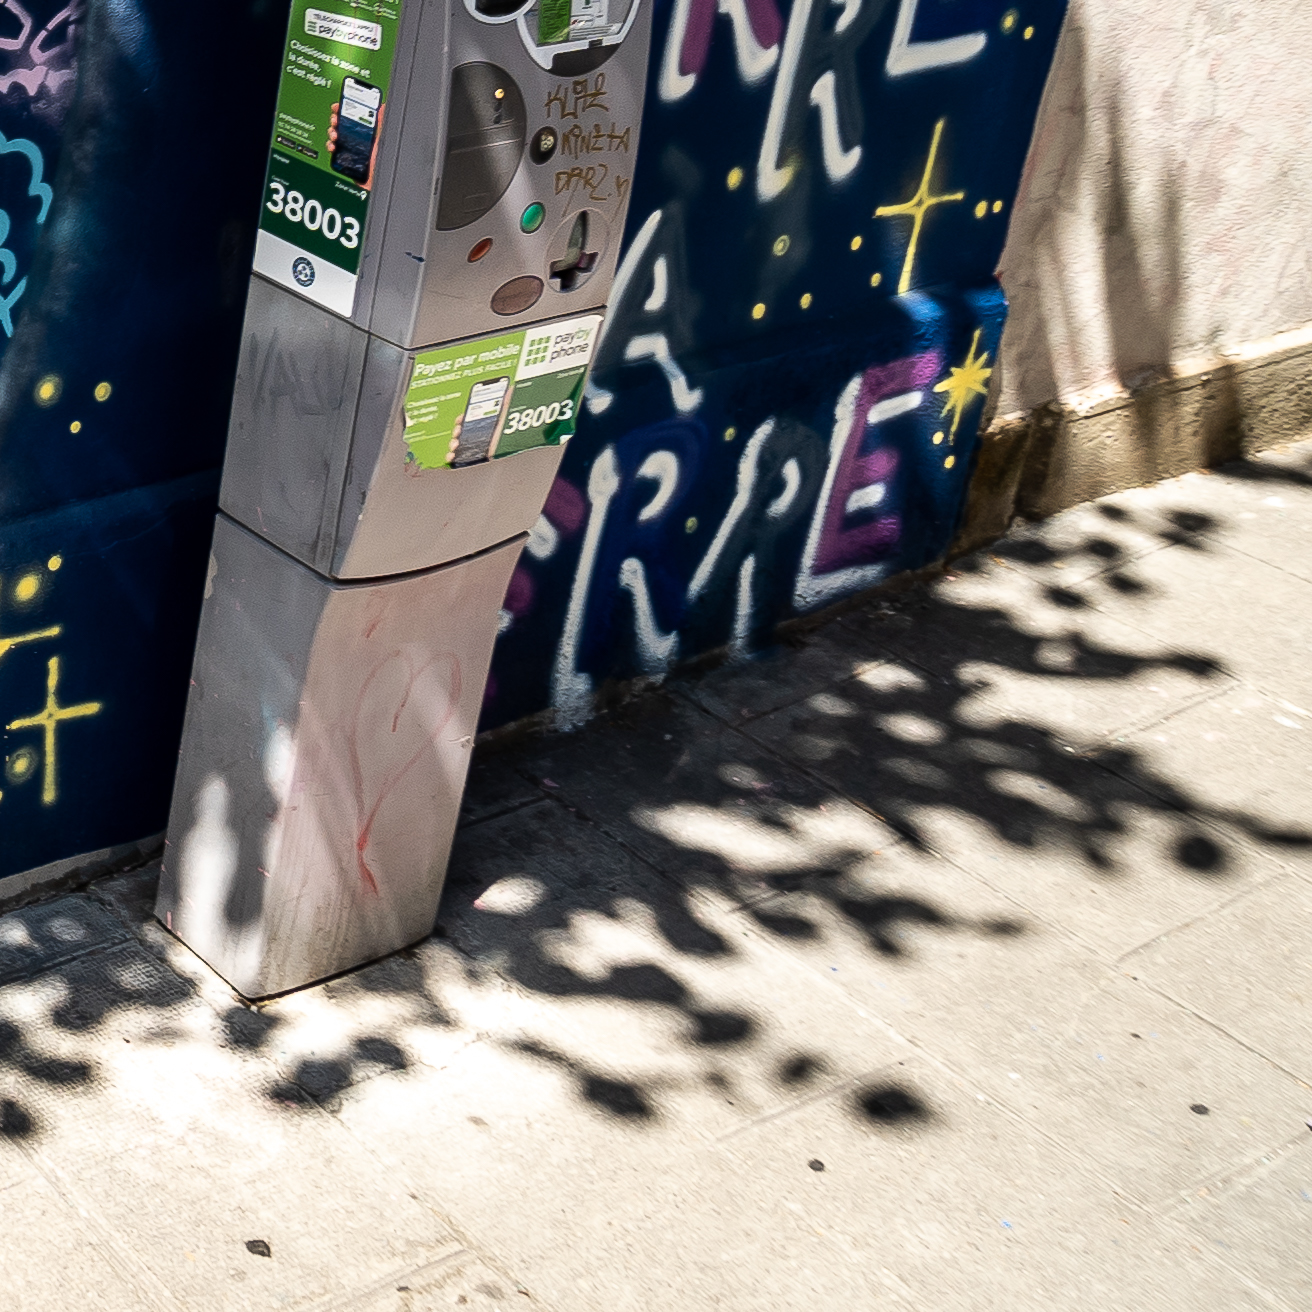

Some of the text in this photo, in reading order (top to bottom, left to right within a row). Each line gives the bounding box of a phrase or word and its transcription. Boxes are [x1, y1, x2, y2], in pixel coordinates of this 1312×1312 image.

[265, 182, 360, 249] 38003
[414, 342, 521, 377] Payez par mobile
[549, 342, 589, 364] phone
[503, 399, 574, 435] 38003
